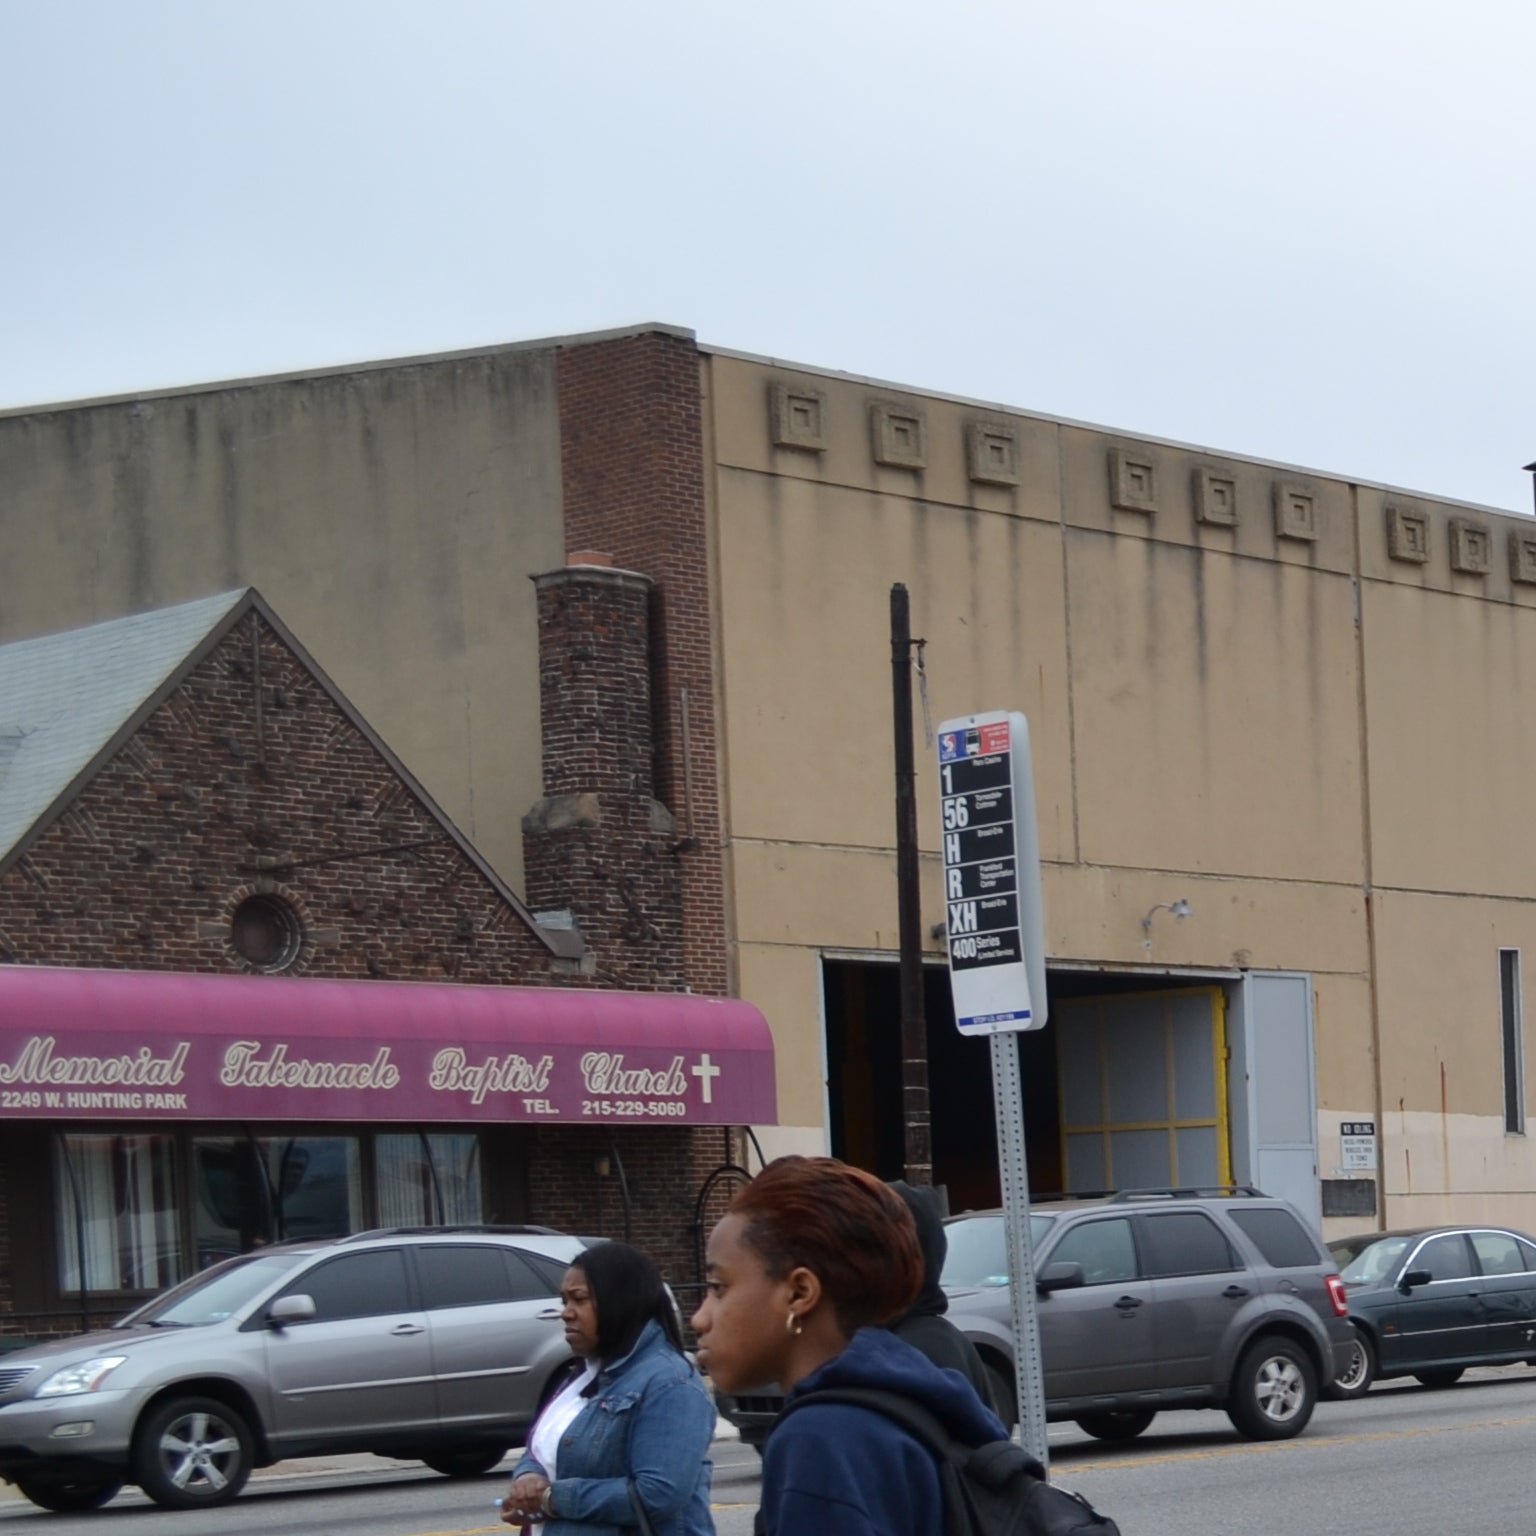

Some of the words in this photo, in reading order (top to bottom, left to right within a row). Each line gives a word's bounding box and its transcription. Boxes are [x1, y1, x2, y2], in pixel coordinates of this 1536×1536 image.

[942, 765, 953, 794] 1
[944, 796, 968, 829] 56
[946, 833, 961, 864] H
[948, 868, 963, 899] R
[950, 901, 977, 934] XH
[953, 938, 977, 959] 400
[976, 936, 1000, 948] Series
[0, 1036, 191, 1086] Memorial
[221, 1041, 400, 1089] Tabernacle
[429, 1047, 553, 1104] Baptist
[581, 1052, 687, 1095] Church
[2, 1091, 41, 1108] 2249
[45, 1092, 64, 1108] W.
[67, 1092, 141, 1109] HUNTING
[145, 1093, 188, 1109] PARK
[523, 1099, 560, 1114] TEL.
[582, 1101, 686, 1116] 215-229-5060
